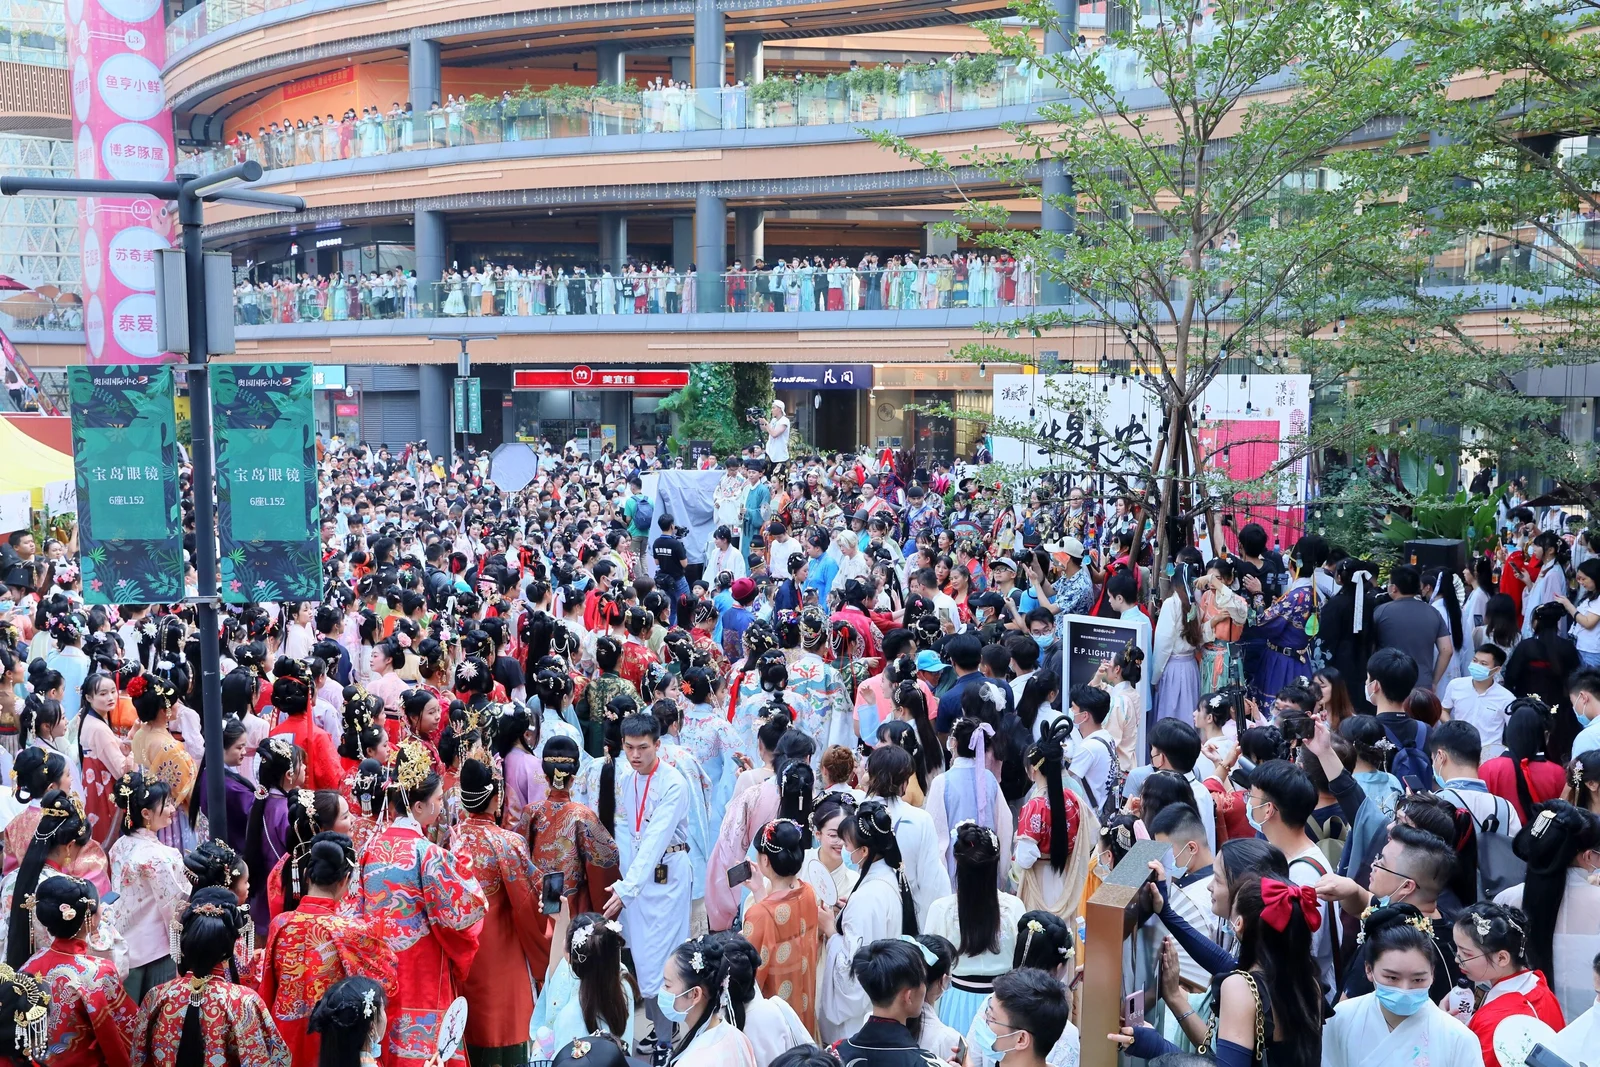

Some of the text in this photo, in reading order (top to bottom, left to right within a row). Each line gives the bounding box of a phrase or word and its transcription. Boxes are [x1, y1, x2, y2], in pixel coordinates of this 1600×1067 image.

[110, 143, 164, 161] 博多豚屋
[119, 314, 158, 332] 泰爱
[93, 377, 138, 386] 奥园国际中心
[237, 379, 283, 387] 奥园国际中心
[602, 375, 636, 384] 美宜佳
[109, 495, 144, 505] 6座L152
[250, 497, 285, 507] 6座L152
